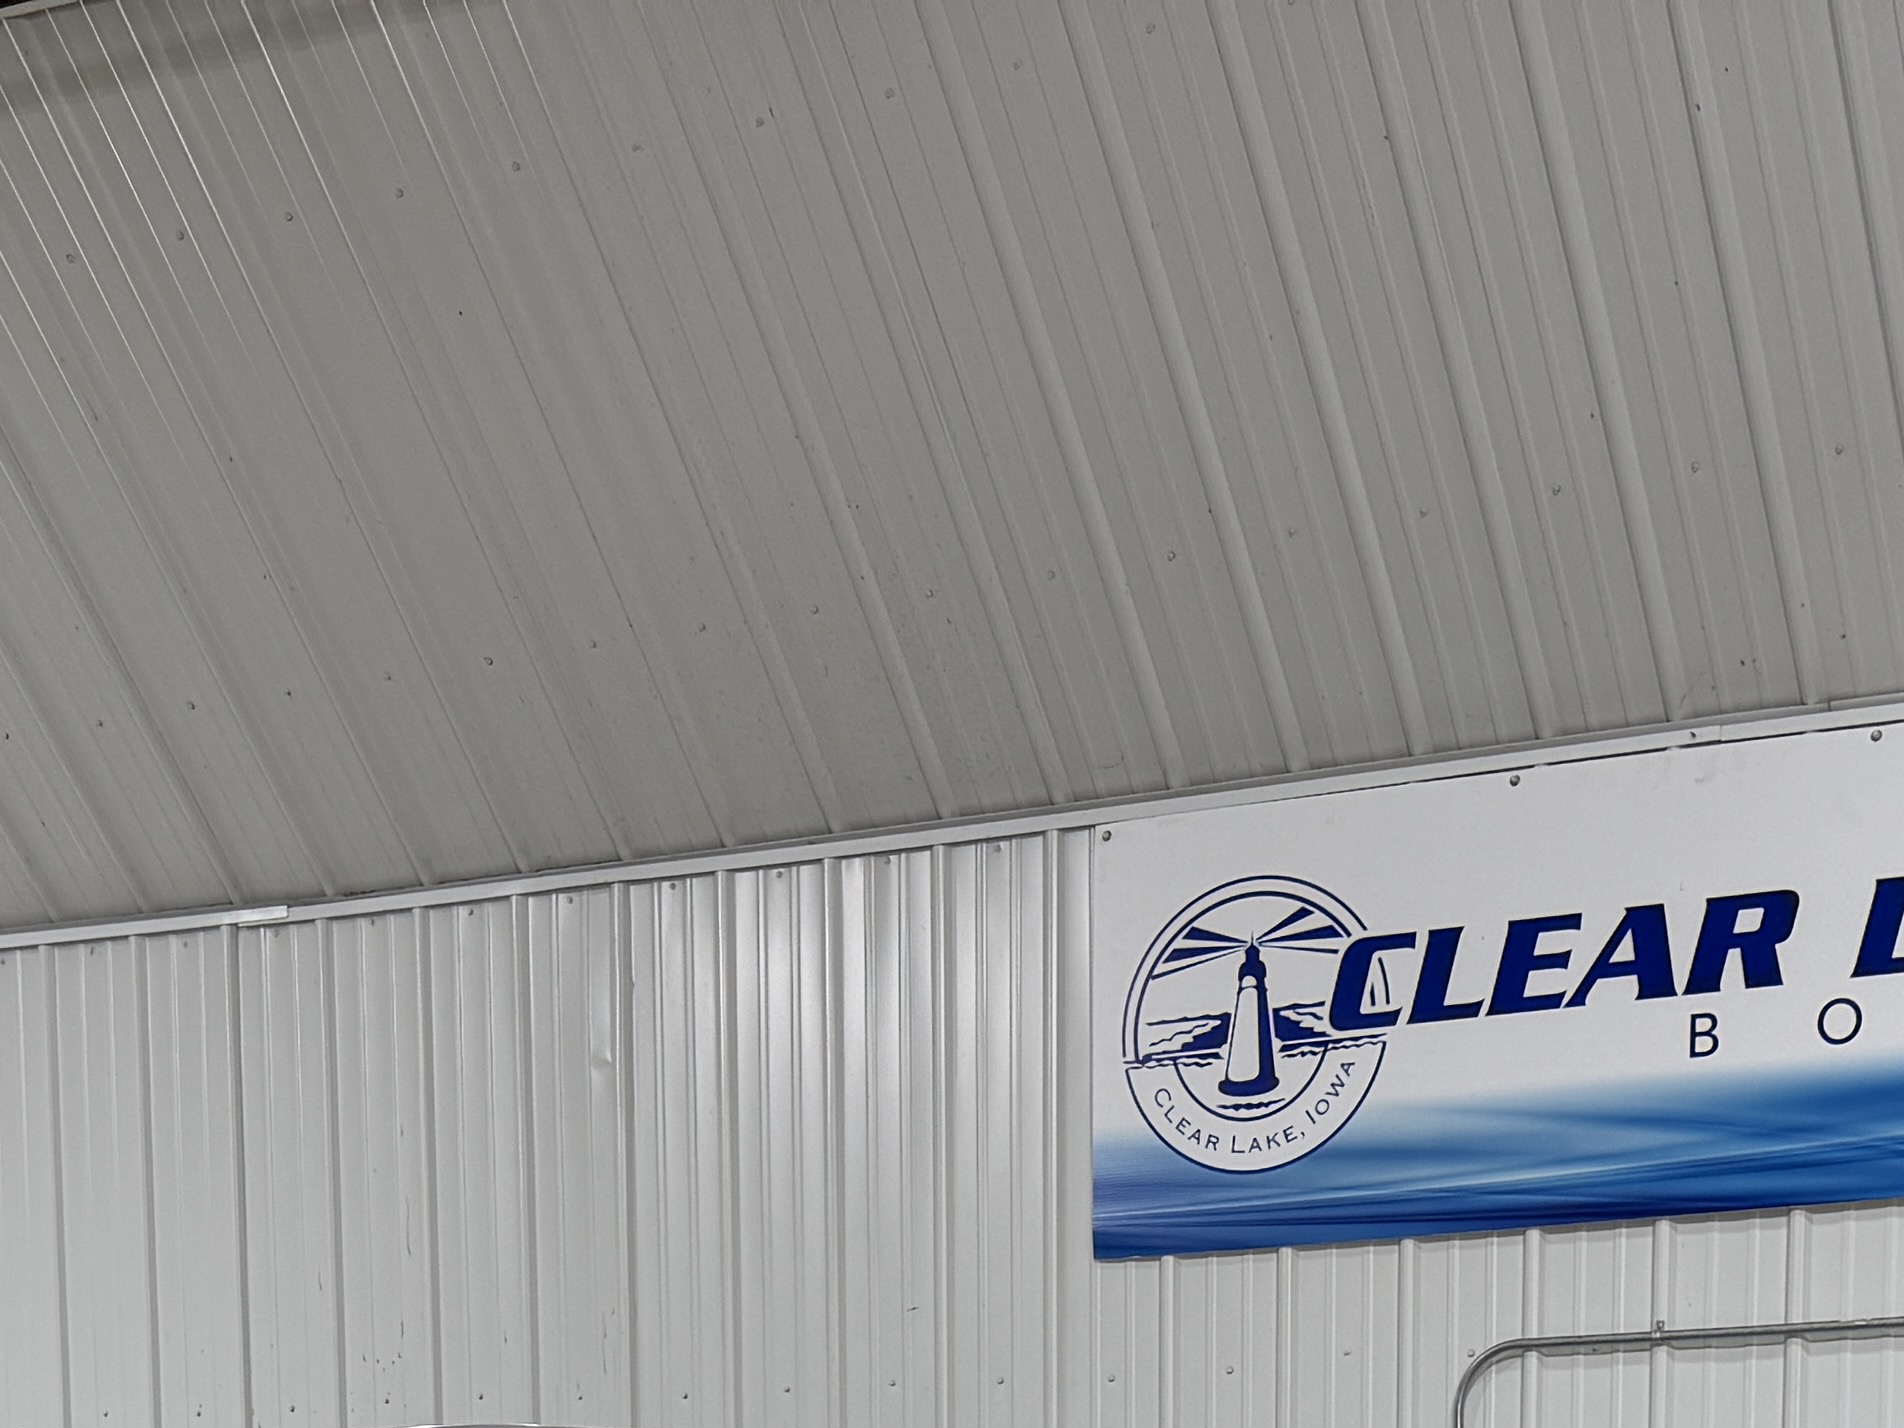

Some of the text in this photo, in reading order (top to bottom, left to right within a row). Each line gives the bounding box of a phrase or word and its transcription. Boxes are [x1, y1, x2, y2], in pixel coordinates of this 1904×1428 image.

[1329, 888, 1801, 1032] CLEAR
[1154, 1060, 1356, 1154] CLEAR LAKE, IOWA
